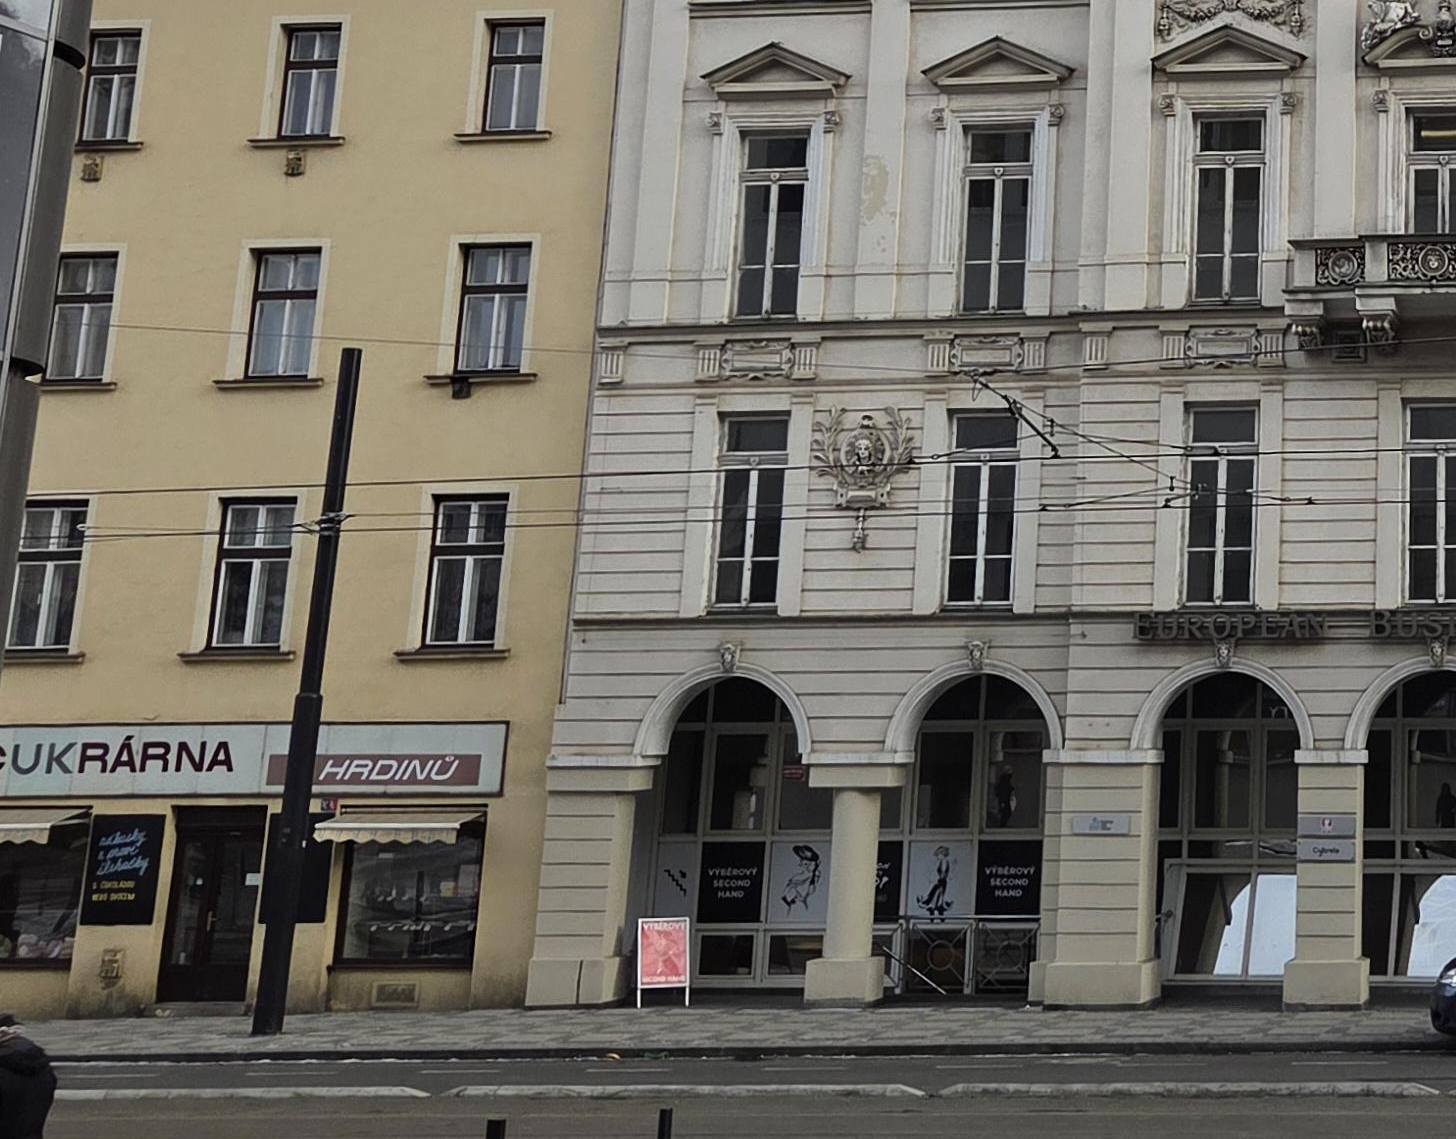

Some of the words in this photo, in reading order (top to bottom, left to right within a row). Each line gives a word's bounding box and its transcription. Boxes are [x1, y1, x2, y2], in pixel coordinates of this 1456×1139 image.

[1133, 611, 1328, 639] EUROPEAN
[318, 755, 460, 781] HRDINŮ
[708, 866, 758, 877] VÝBĚROVÝ
[985, 865, 1035, 876] VÝBĚROVÝ
[713, 879, 751, 888] SECOND
[990, 878, 1029, 887] SECOND
[718, 890, 745, 899] HAND
[995, 889, 1023, 898] HAND
